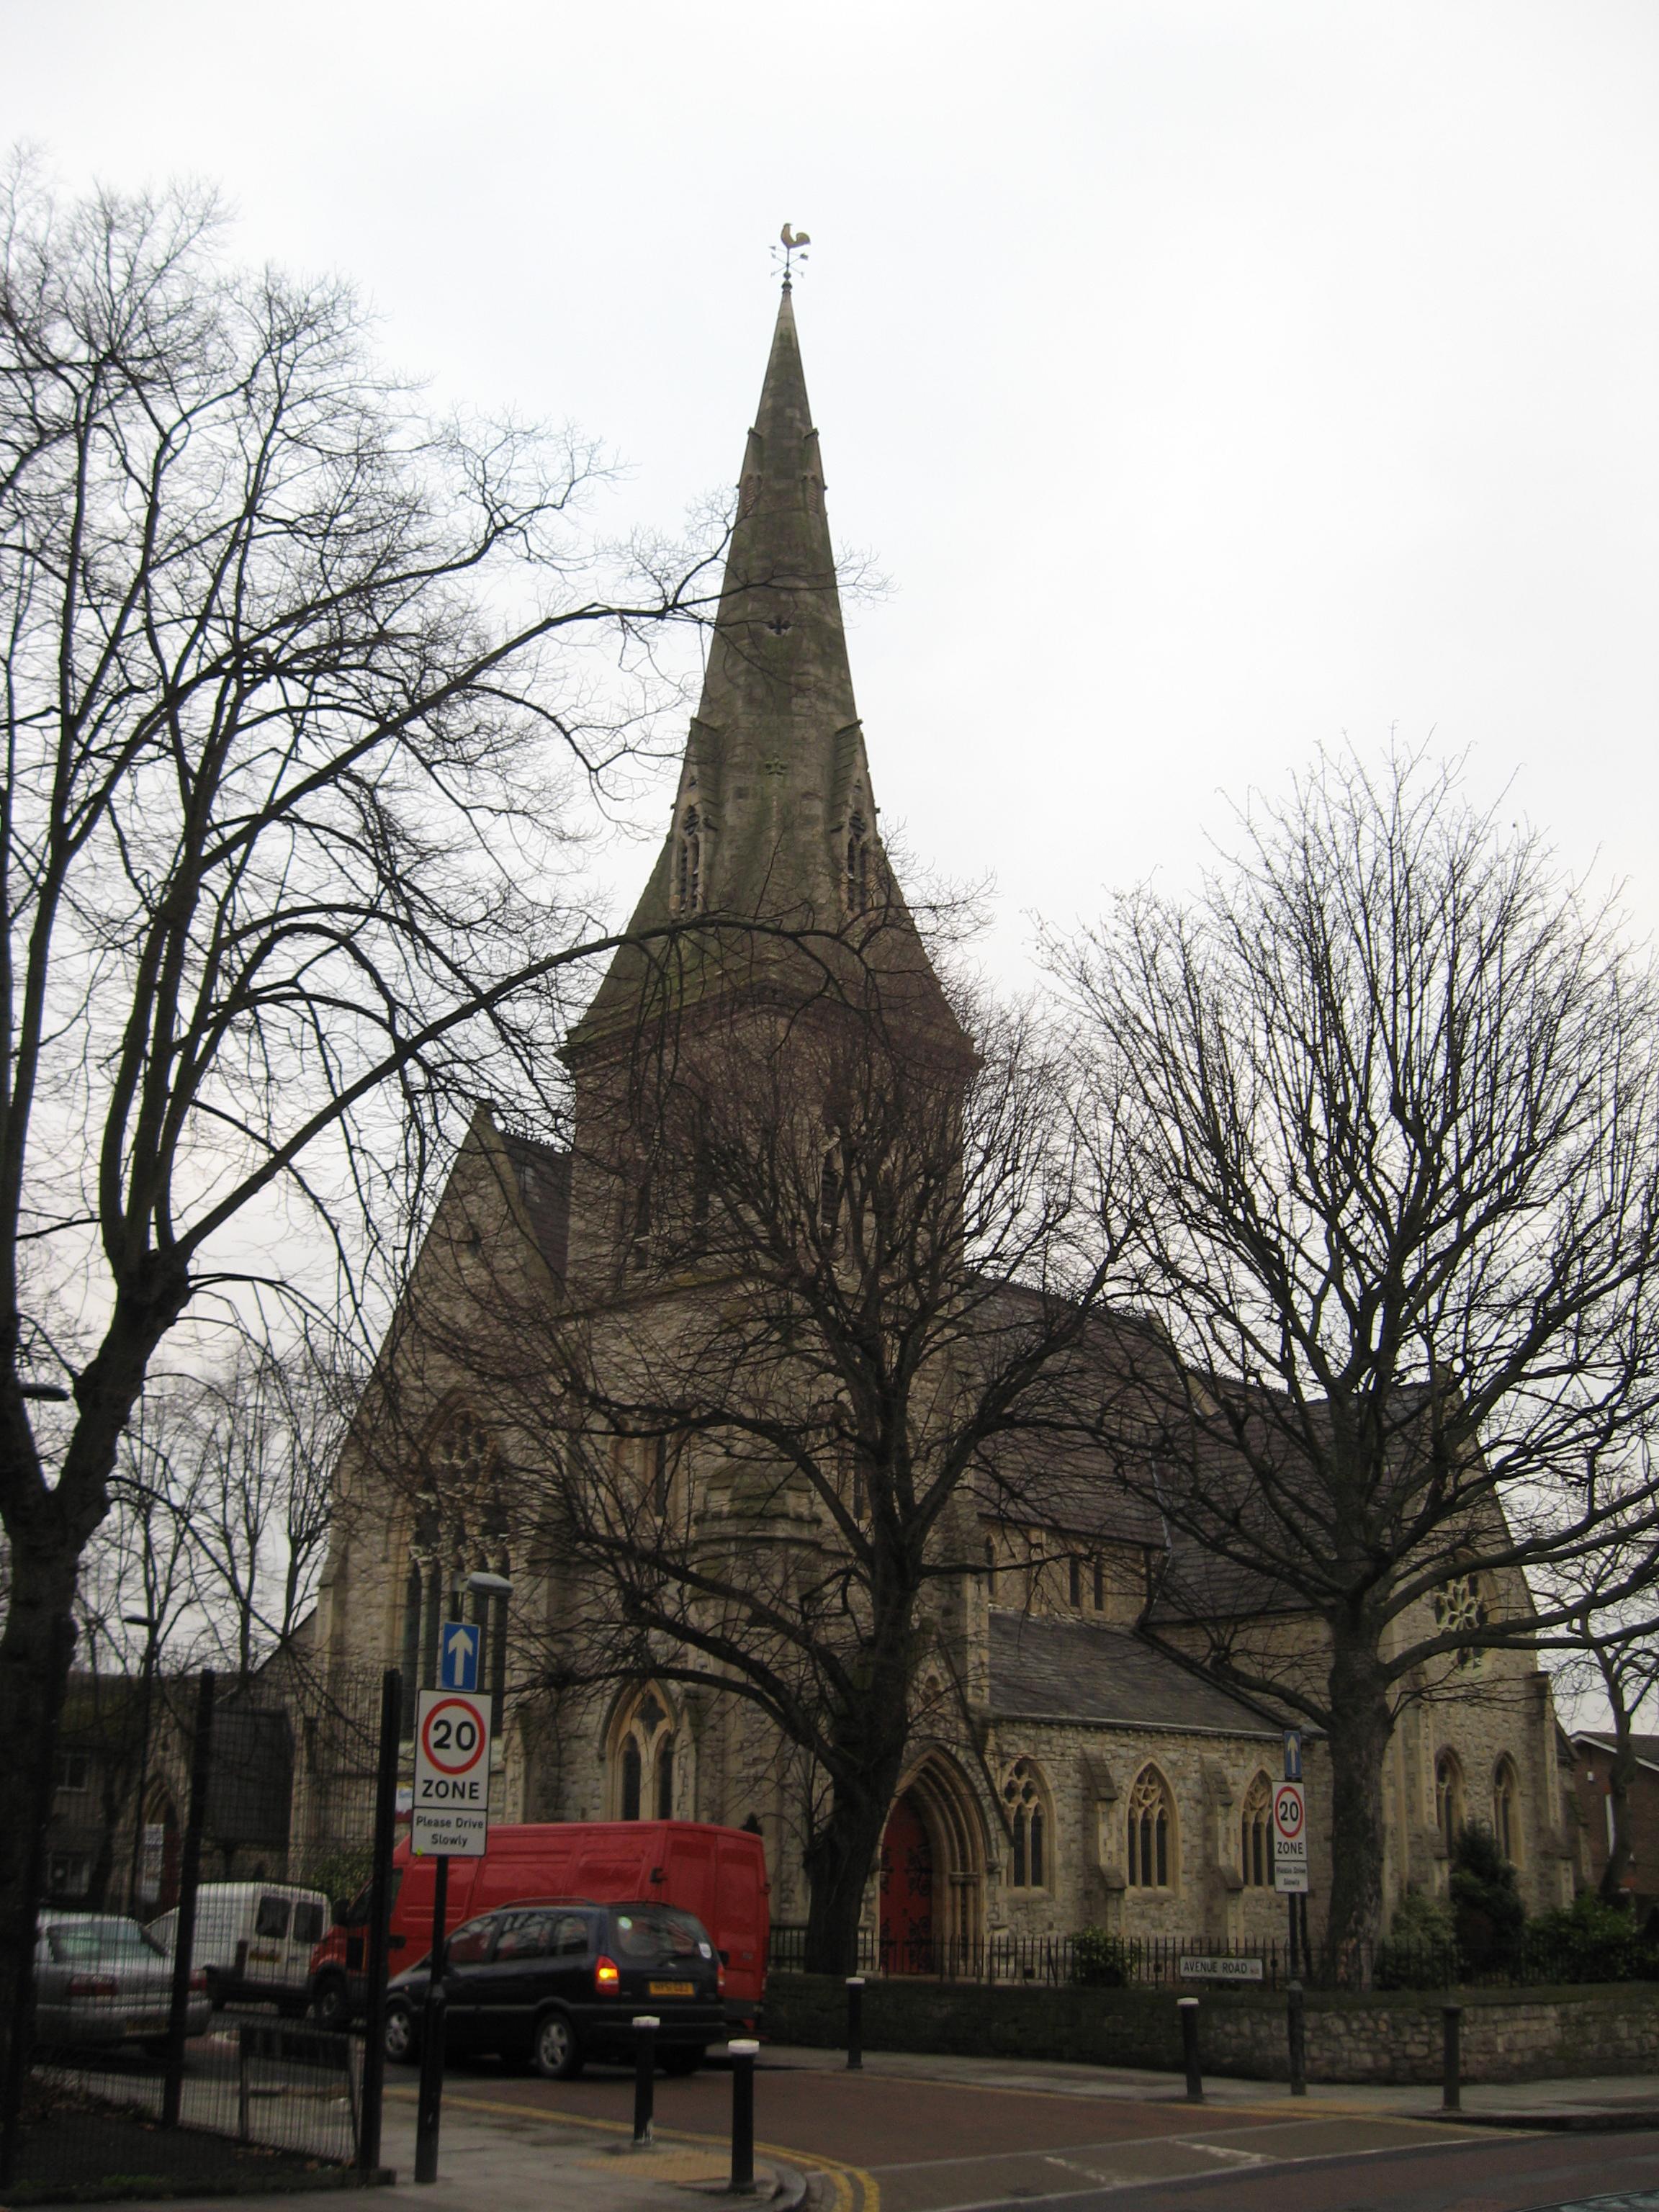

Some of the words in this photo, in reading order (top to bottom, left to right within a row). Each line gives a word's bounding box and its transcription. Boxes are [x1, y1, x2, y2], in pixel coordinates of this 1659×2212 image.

[433, 1719, 476, 1751] 20
[422, 1779, 480, 1799] ZONE
[1280, 1801, 1298, 1822] 20
[416, 1816, 451, 1828] Please
[456, 1818, 484, 1829] Drive
[431, 1833, 467, 1848] Slowly
[1277, 1842, 1303, 1854] ZONE
[1184, 1961, 1218, 1973] AVENUE
[1222, 1963, 1247, 1974] ROAD
